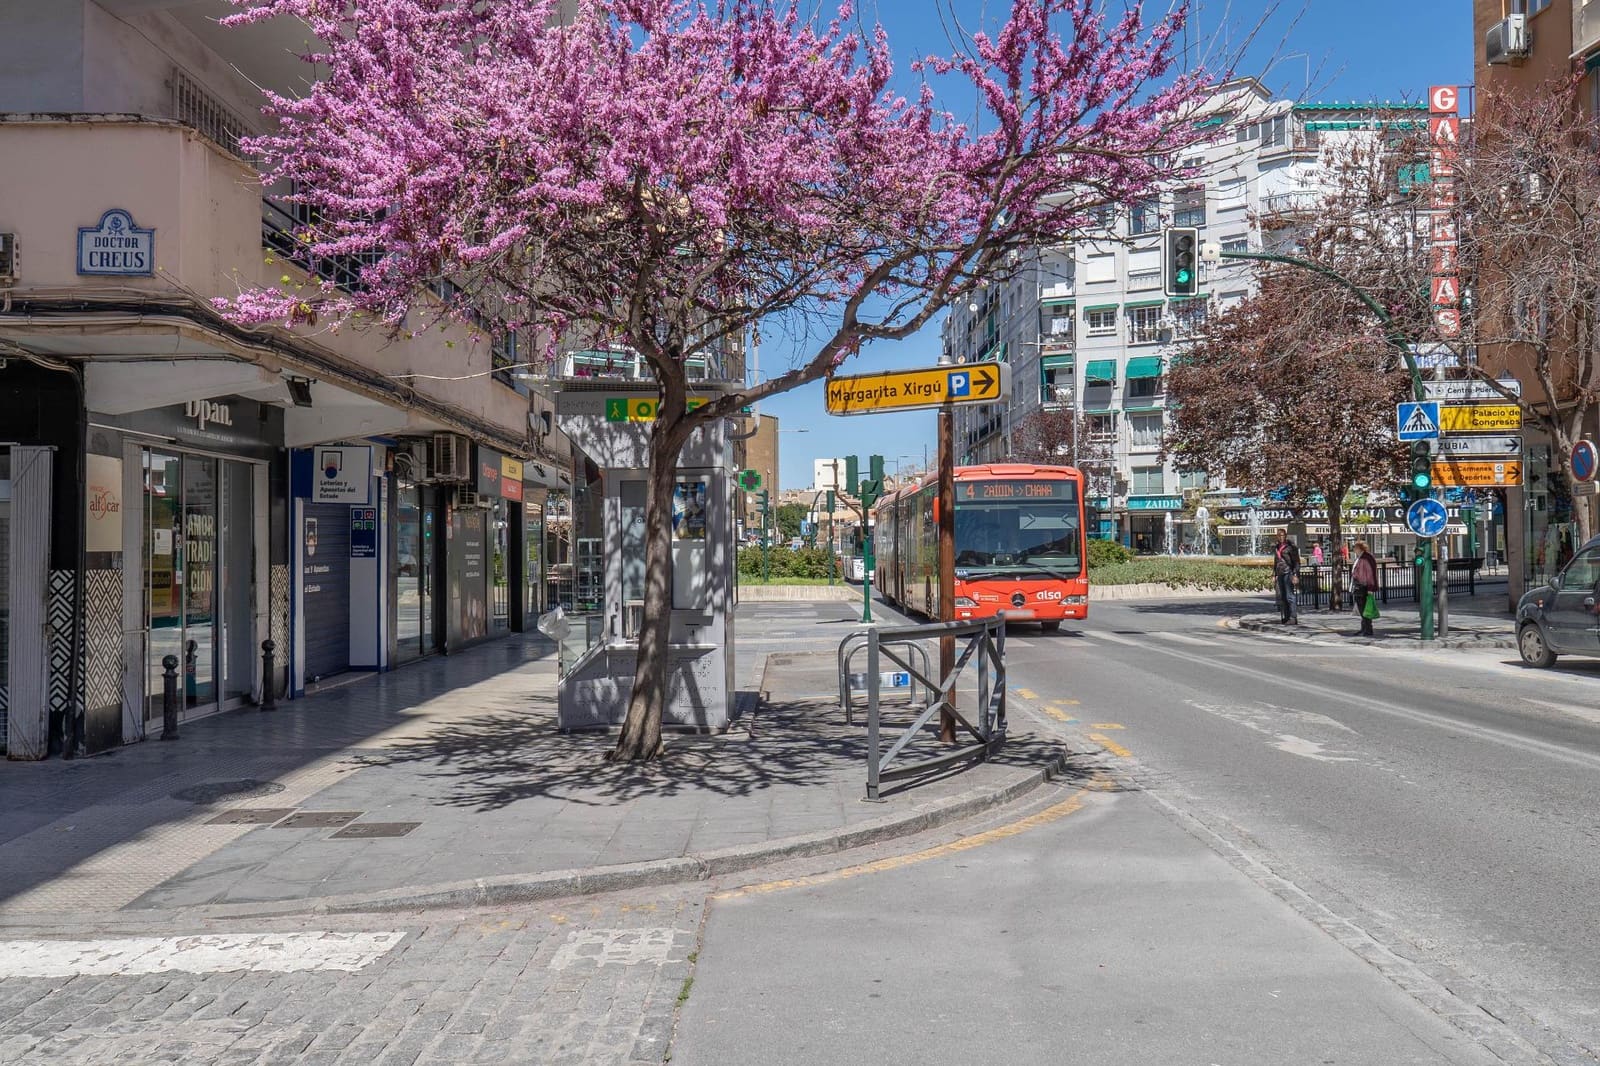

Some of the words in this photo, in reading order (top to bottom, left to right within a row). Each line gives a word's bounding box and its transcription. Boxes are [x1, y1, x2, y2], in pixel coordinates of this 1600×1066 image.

[94, 236, 139, 249] DOCTOR
[89, 251, 144, 268] CREUS
[831, 386, 897, 402] Margarita
[903, 380, 941, 397] Xirgú
[1509, 409, 1520, 417] de
[1472, 419, 1520, 428] Congresos
[966, 483, 975, 498] 4
[1025, 485, 1052, 497] CHANA
[1145, 500, 1182, 509] ZAIDIN
[1036, 590, 1062, 600] alsa
